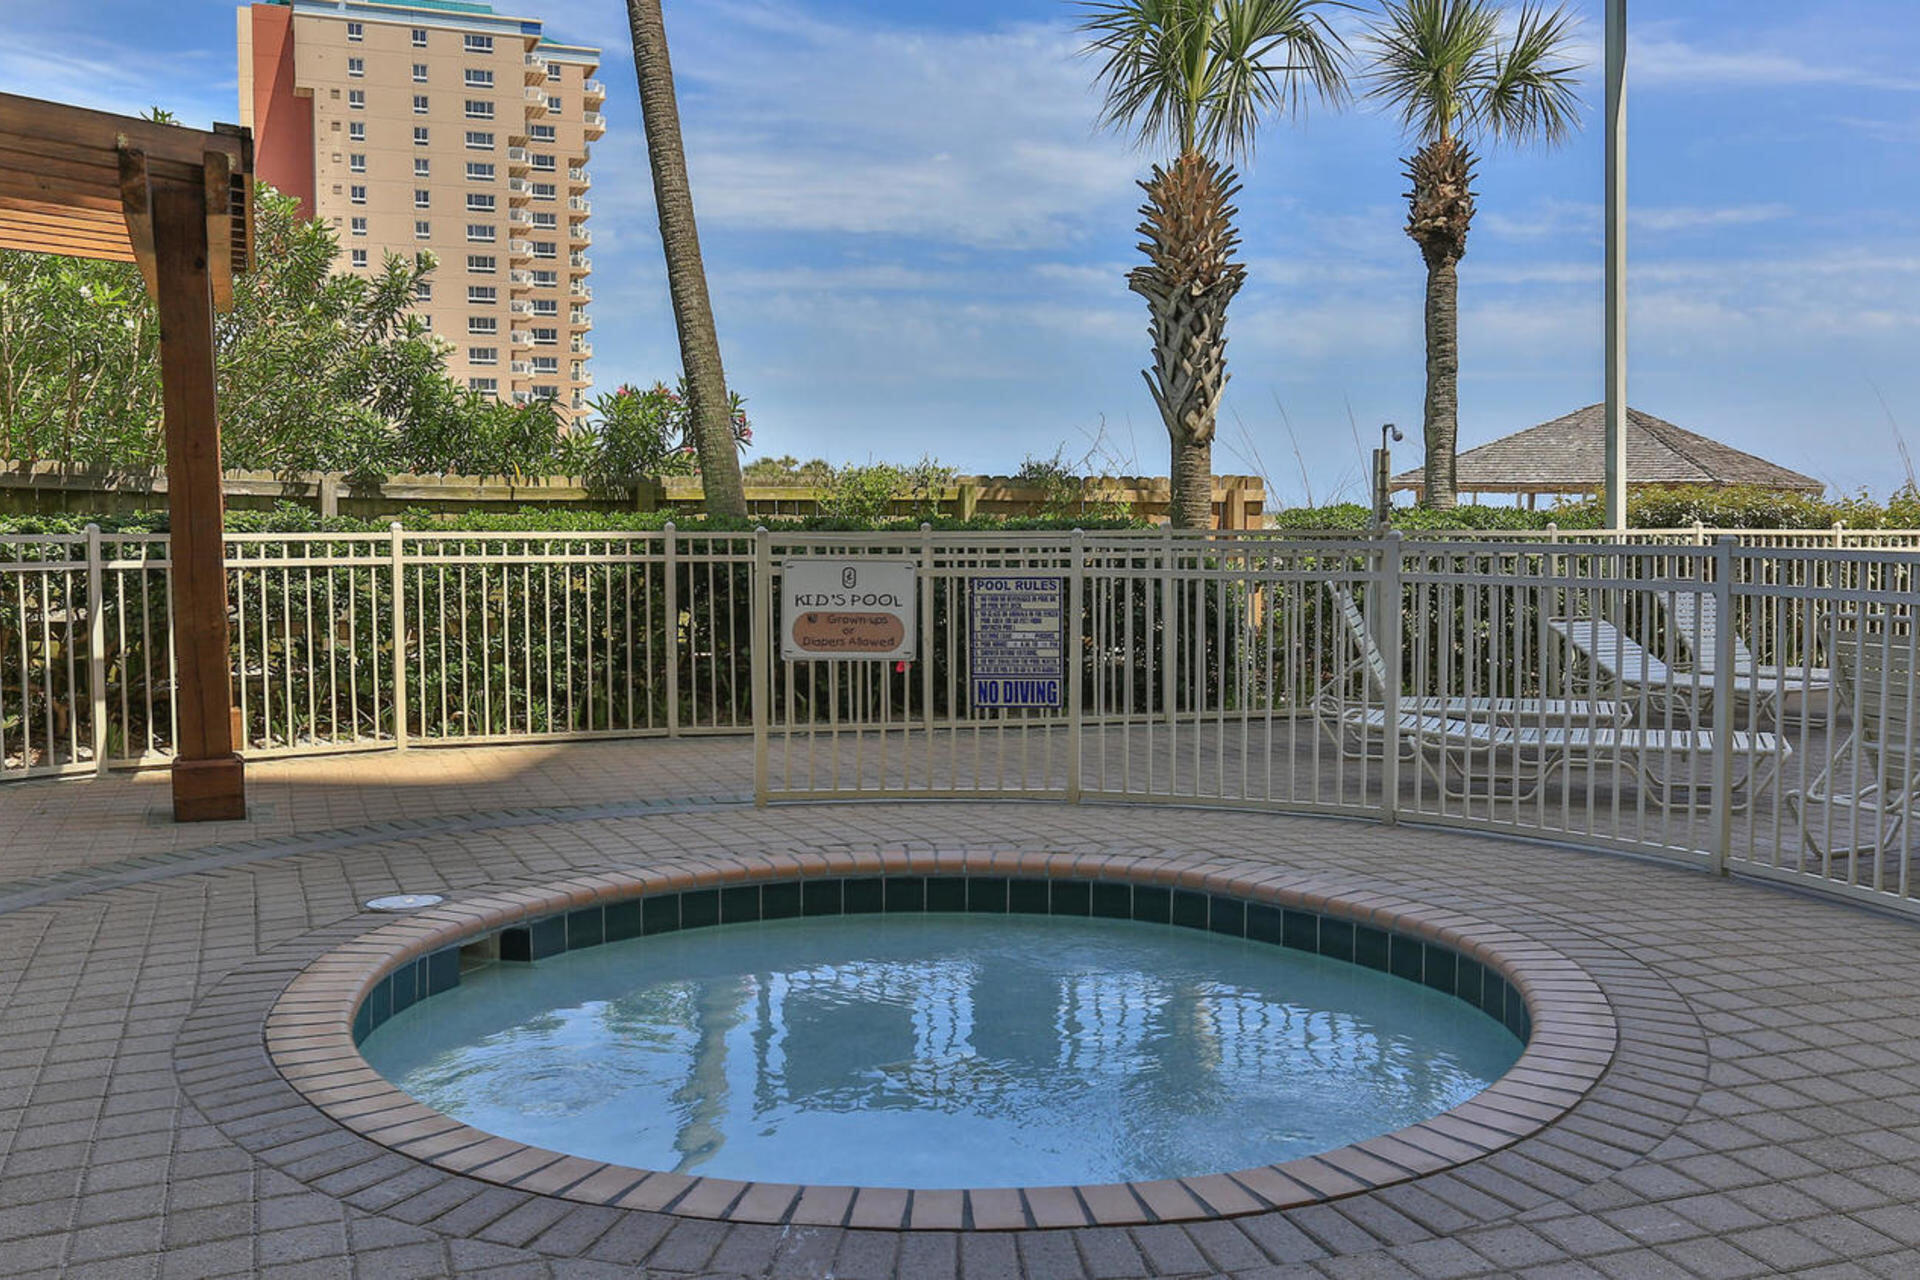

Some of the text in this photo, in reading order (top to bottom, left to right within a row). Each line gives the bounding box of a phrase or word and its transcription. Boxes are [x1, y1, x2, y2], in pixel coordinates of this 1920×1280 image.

[977, 580, 1057, 591] POOL RULES
[795, 594, 902, 607] KID'S POOL
[842, 628, 856, 636] or
[802, 636, 895, 648] Diapers Allowed
[978, 681, 1057, 703] NO DIVING
